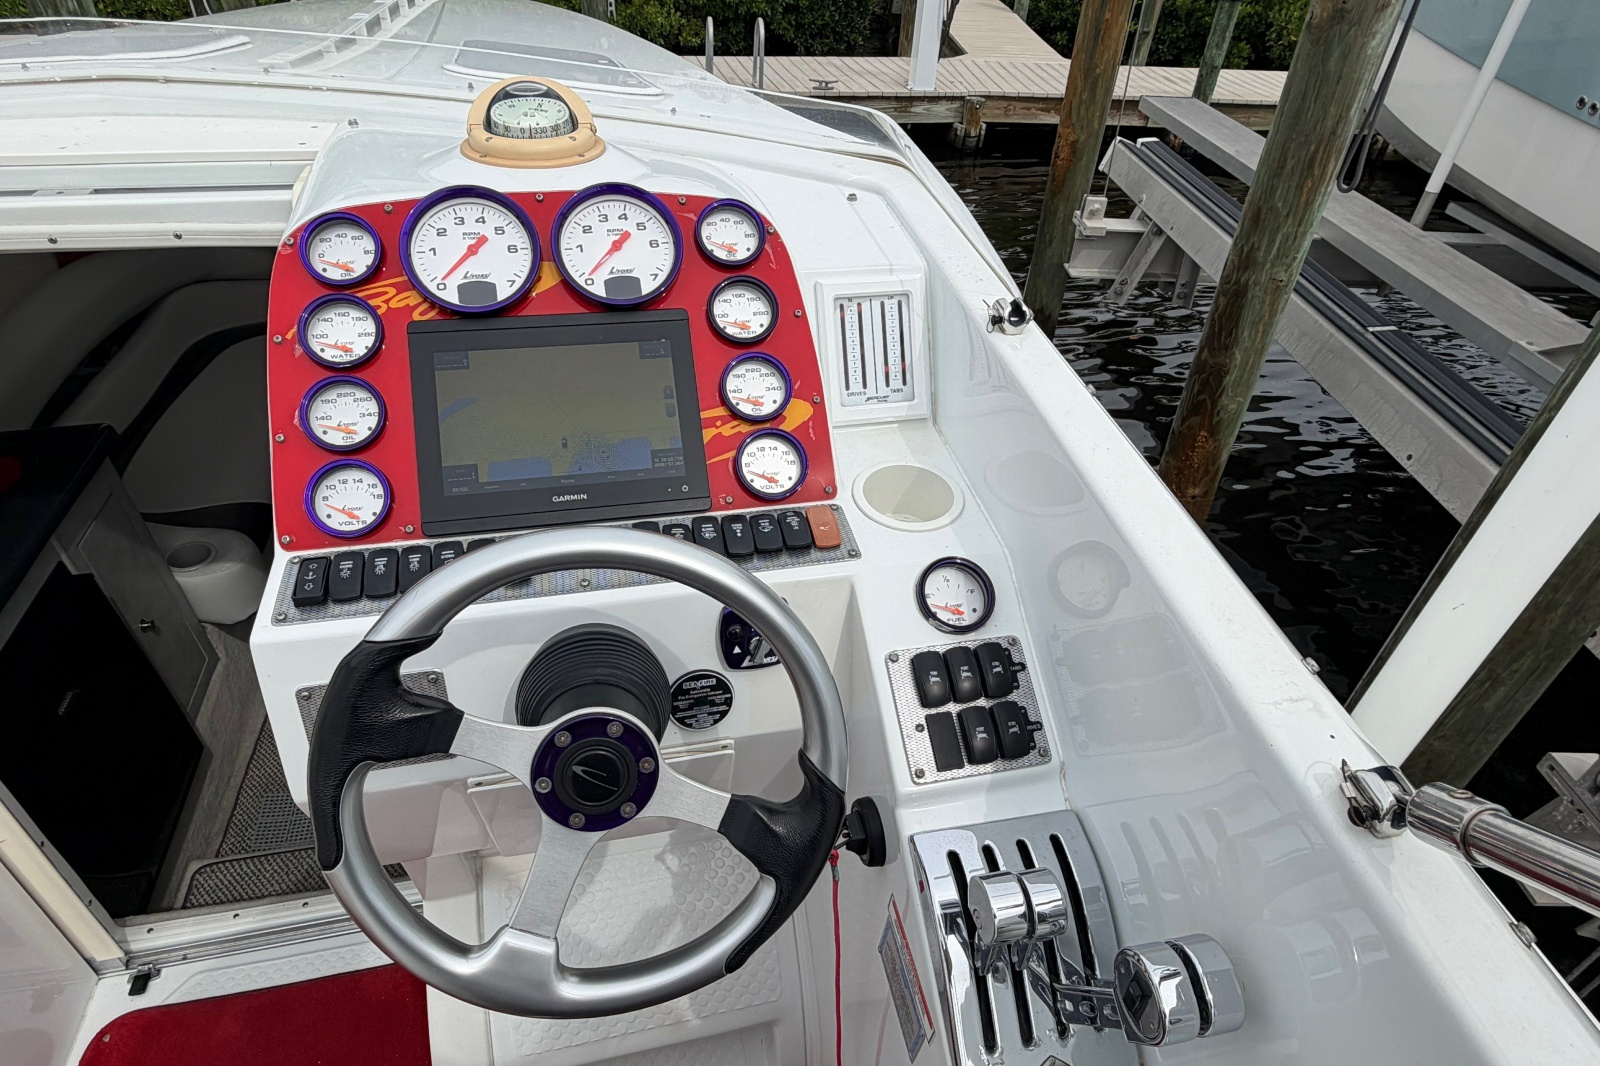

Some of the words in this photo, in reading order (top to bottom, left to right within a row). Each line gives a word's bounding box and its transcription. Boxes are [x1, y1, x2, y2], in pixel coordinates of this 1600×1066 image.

[453, 217, 465, 226] 3
[474, 216, 487, 225] 4
[598, 214, 609, 223] 3
[618, 213, 629, 221] 4
[494, 226, 505, 235] 5
[582, 225, 593, 234] 2
[636, 222, 646, 231] 5
[436, 228, 448, 237] 2
[507, 244, 518, 254] 6
[575, 244, 584, 253] 1
[649, 240, 660, 249] 6
[429, 248, 436, 256] 1
[436, 282, 447, 291] 0
[506, 280, 516, 288] 7
[584, 278, 594, 286] 0
[552, 493, 587, 502] GARMIN
